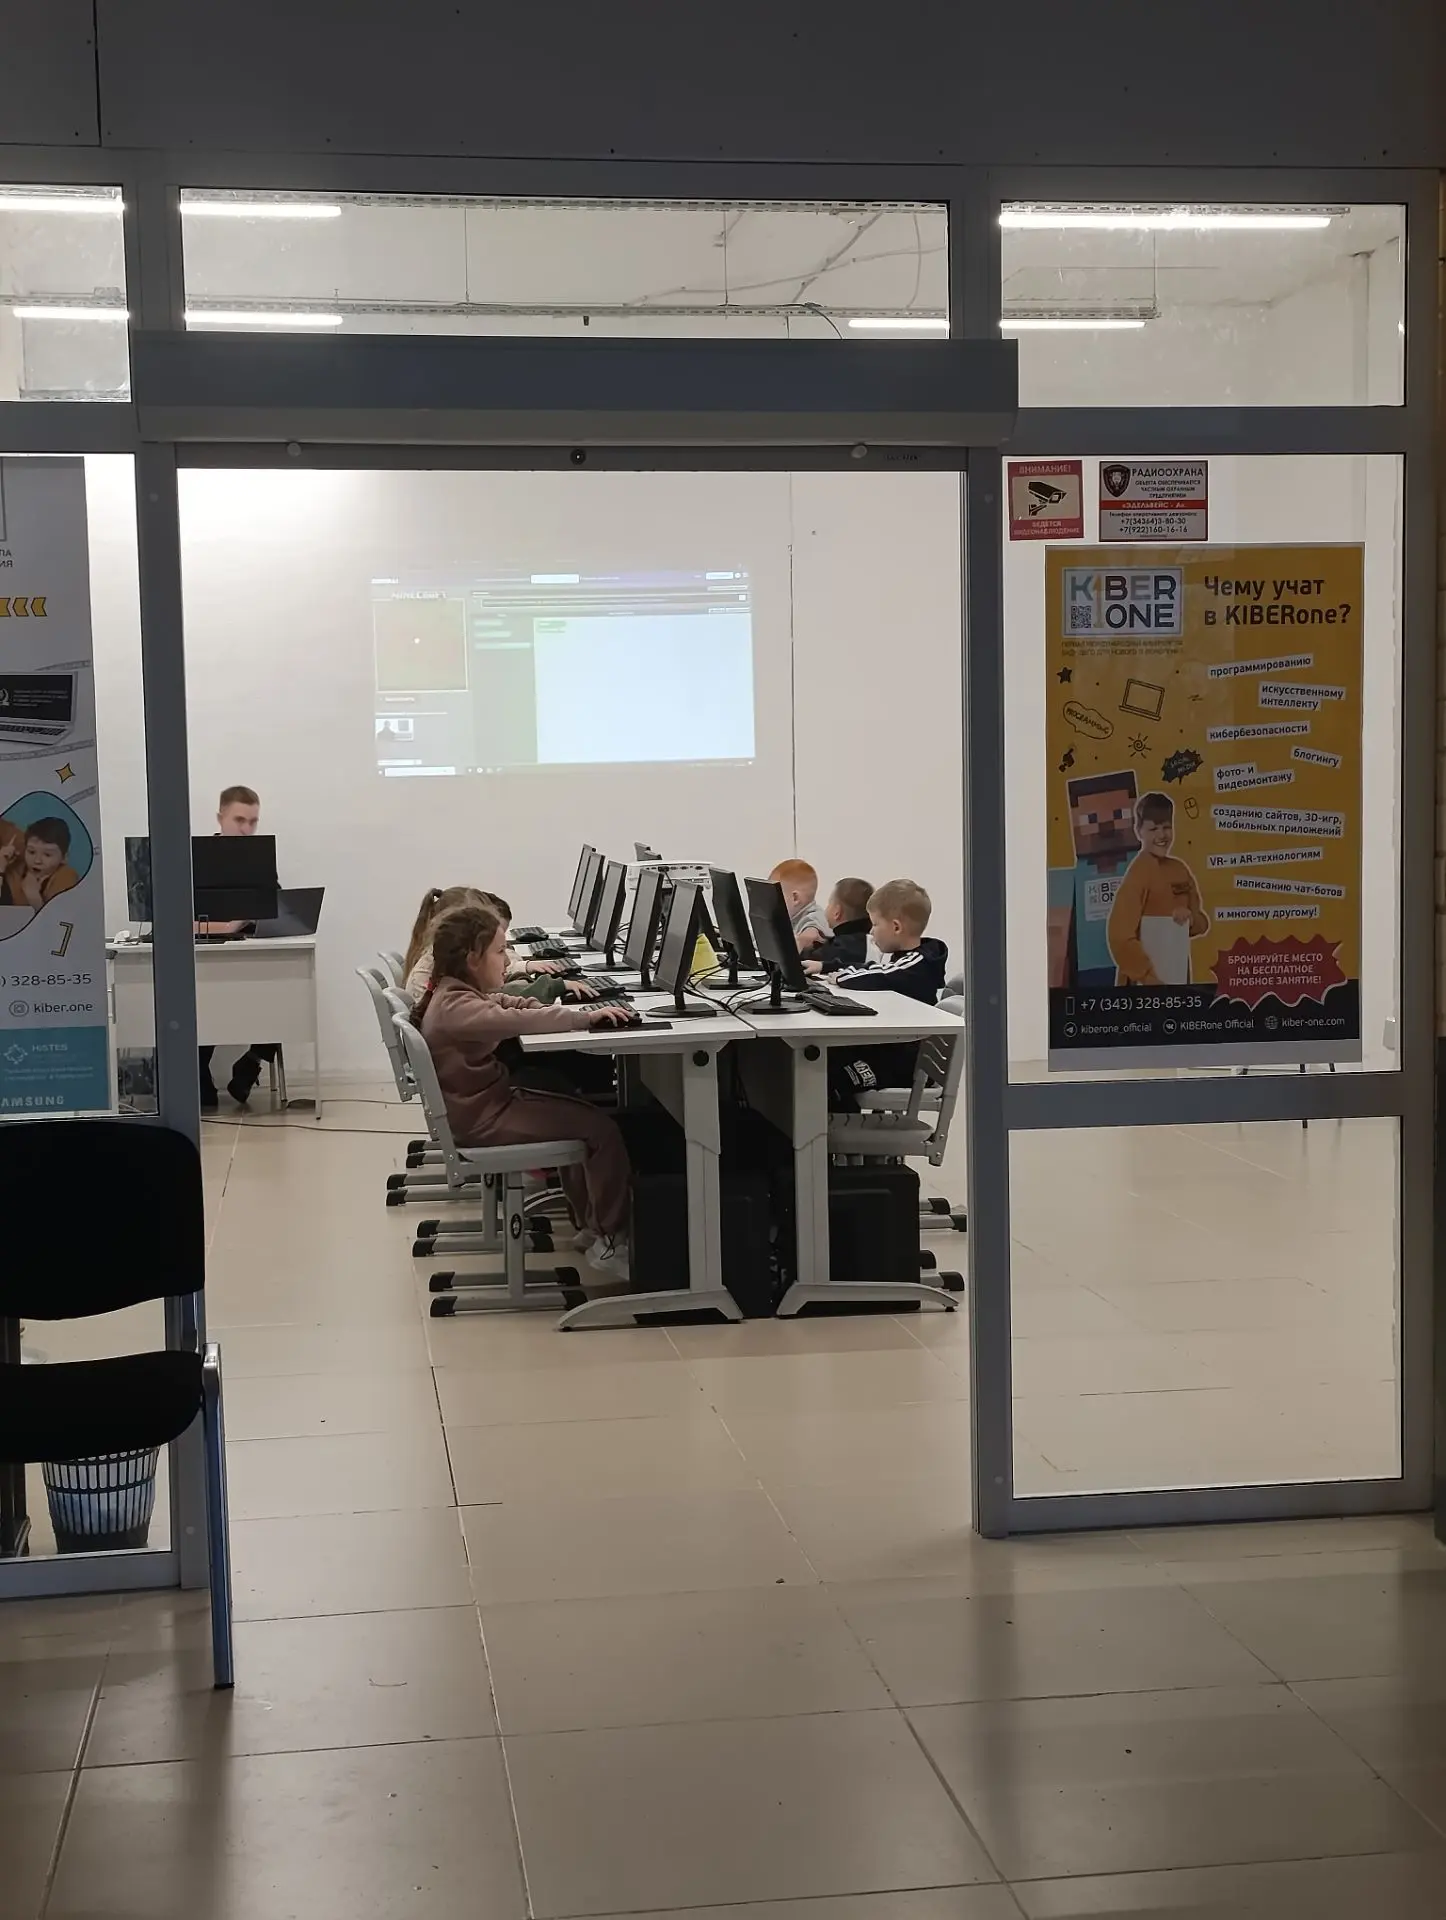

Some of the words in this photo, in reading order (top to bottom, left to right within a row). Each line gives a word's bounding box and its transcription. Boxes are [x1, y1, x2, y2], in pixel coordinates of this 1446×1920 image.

[1132, 468, 1204, 477] РАДИООХРАНА
[1119, 526, 1188, 534] +7(922)160-16-16
[1204, 575, 1266, 600] Чему
[1272, 579, 1325, 600] учат
[1105, 603, 1175, 628] ONE
[1204, 609, 1217, 625] в
[1225, 603, 1352, 625] KIBERone?
[1210, 656, 1312, 678] программированию
[1262, 684, 1344, 699] искусственному
[1261, 698, 1319, 710] интеллекту
[1209, 723, 1308, 741] кибербезопасности
[1293, 748, 1339, 768] блогингу
[1216, 767, 1245, 780] фото-
[1247, 766, 1254, 774] и
[1218, 772, 1293, 791] видеомонтажу
[1213, 807, 1263, 819] созданию
[1265, 810, 1302, 822] сайтов,
[1305, 812, 1342, 825] 3D-игр,
[1218, 819, 1276, 832] мобильных
[1278, 823, 1341, 836] приложений
[1209, 856, 1228, 866] VR-
[1239, 849, 1321, 864] AR-технологиям
[1236, 878, 1292, 891] написанию
[1294, 883, 1343, 897] чат-ботов
[1226, 909, 1270, 920] многому
[1272, 907, 1318, 919] другому!
[1228, 952, 1290, 965] БРОНИРУЙТЕ
[1291, 953, 1324, 962] МЕСТО
[1237, 966, 1250, 975] НА
[1252, 964, 1314, 974] БЕСПЛАТНОЕ
[10, 973, 92, 987] 328-85-35
[1229, 977, 1275, 986] ПРОБНОЕ
[1276, 975, 1322, 985] ЗАНЯТИЕ!
[34, 1002, 94, 1013] kiber.one
[1081, 999, 1096, 1011] +7
[1100, 998, 1133, 1011] (343)
[1135, 996, 1202, 1010] 328-85-35
[1081, 1022, 1152, 1034] kiberone_official
[1180, 1019, 1223, 1030] KIBERone
[1224, 1018, 1255, 1029] Official
[1281, 1017, 1345, 1027] kiber-one.com
